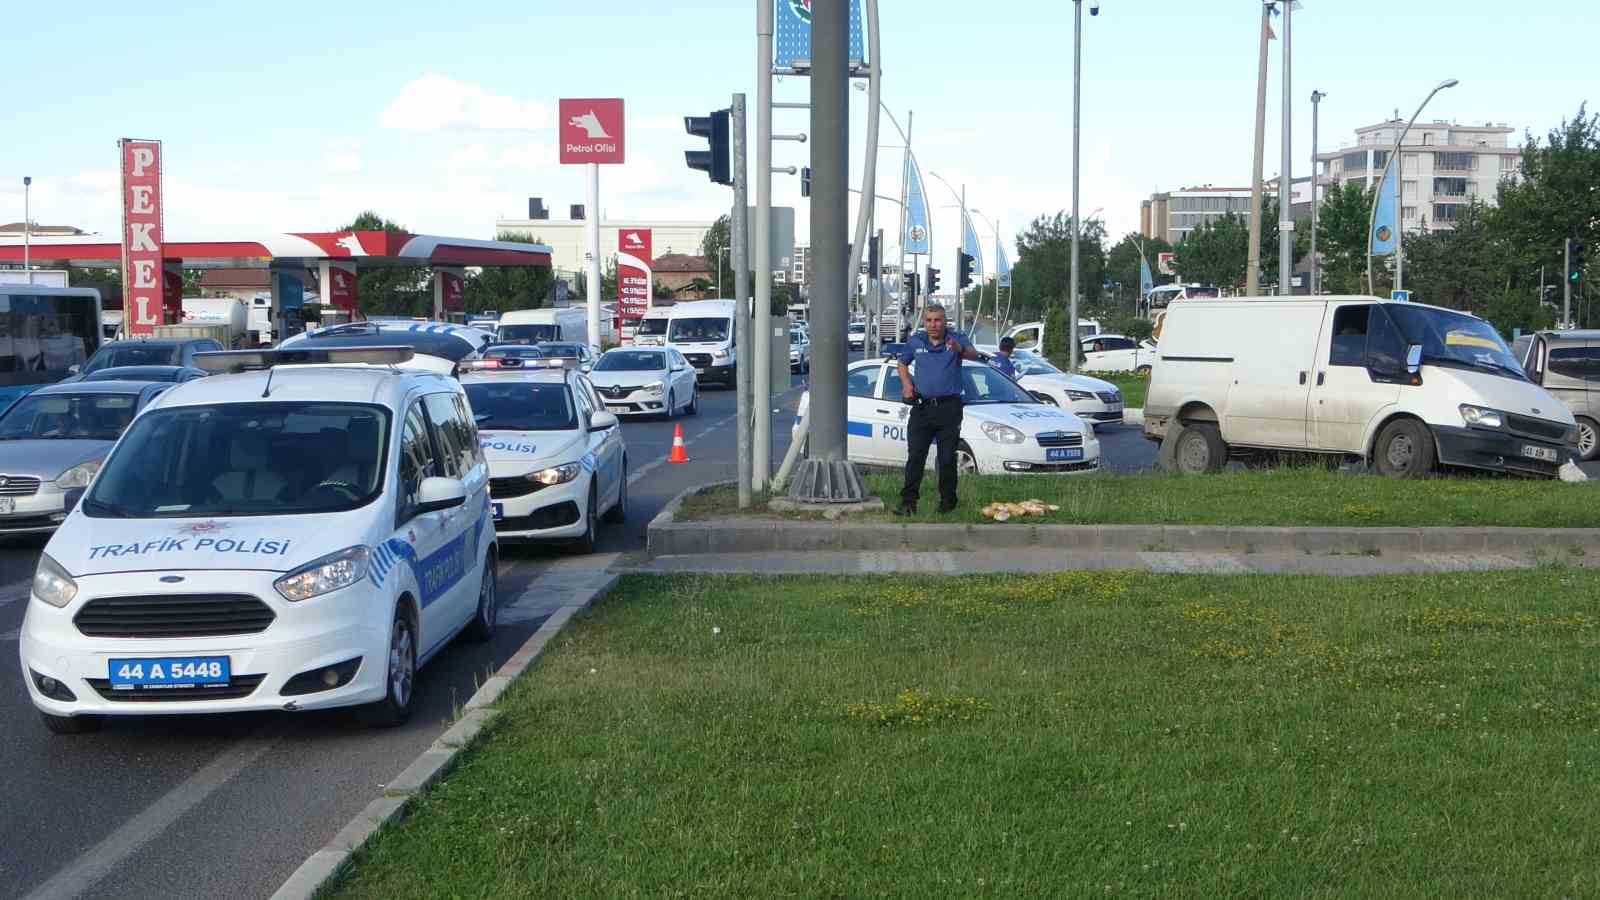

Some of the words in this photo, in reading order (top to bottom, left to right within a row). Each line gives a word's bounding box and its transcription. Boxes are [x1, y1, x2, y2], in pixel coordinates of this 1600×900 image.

[566, 143, 593, 153] Petrol
[594, 143, 616, 153] Ofisi
[131, 148, 159, 326] PEKEL
[89, 537, 190, 560] TRAFİK
[194, 537, 291, 556] POLİSİ
[118, 664, 145, 680] 44
[150, 663, 166, 679] A
[171, 662, 222, 679] 5448
